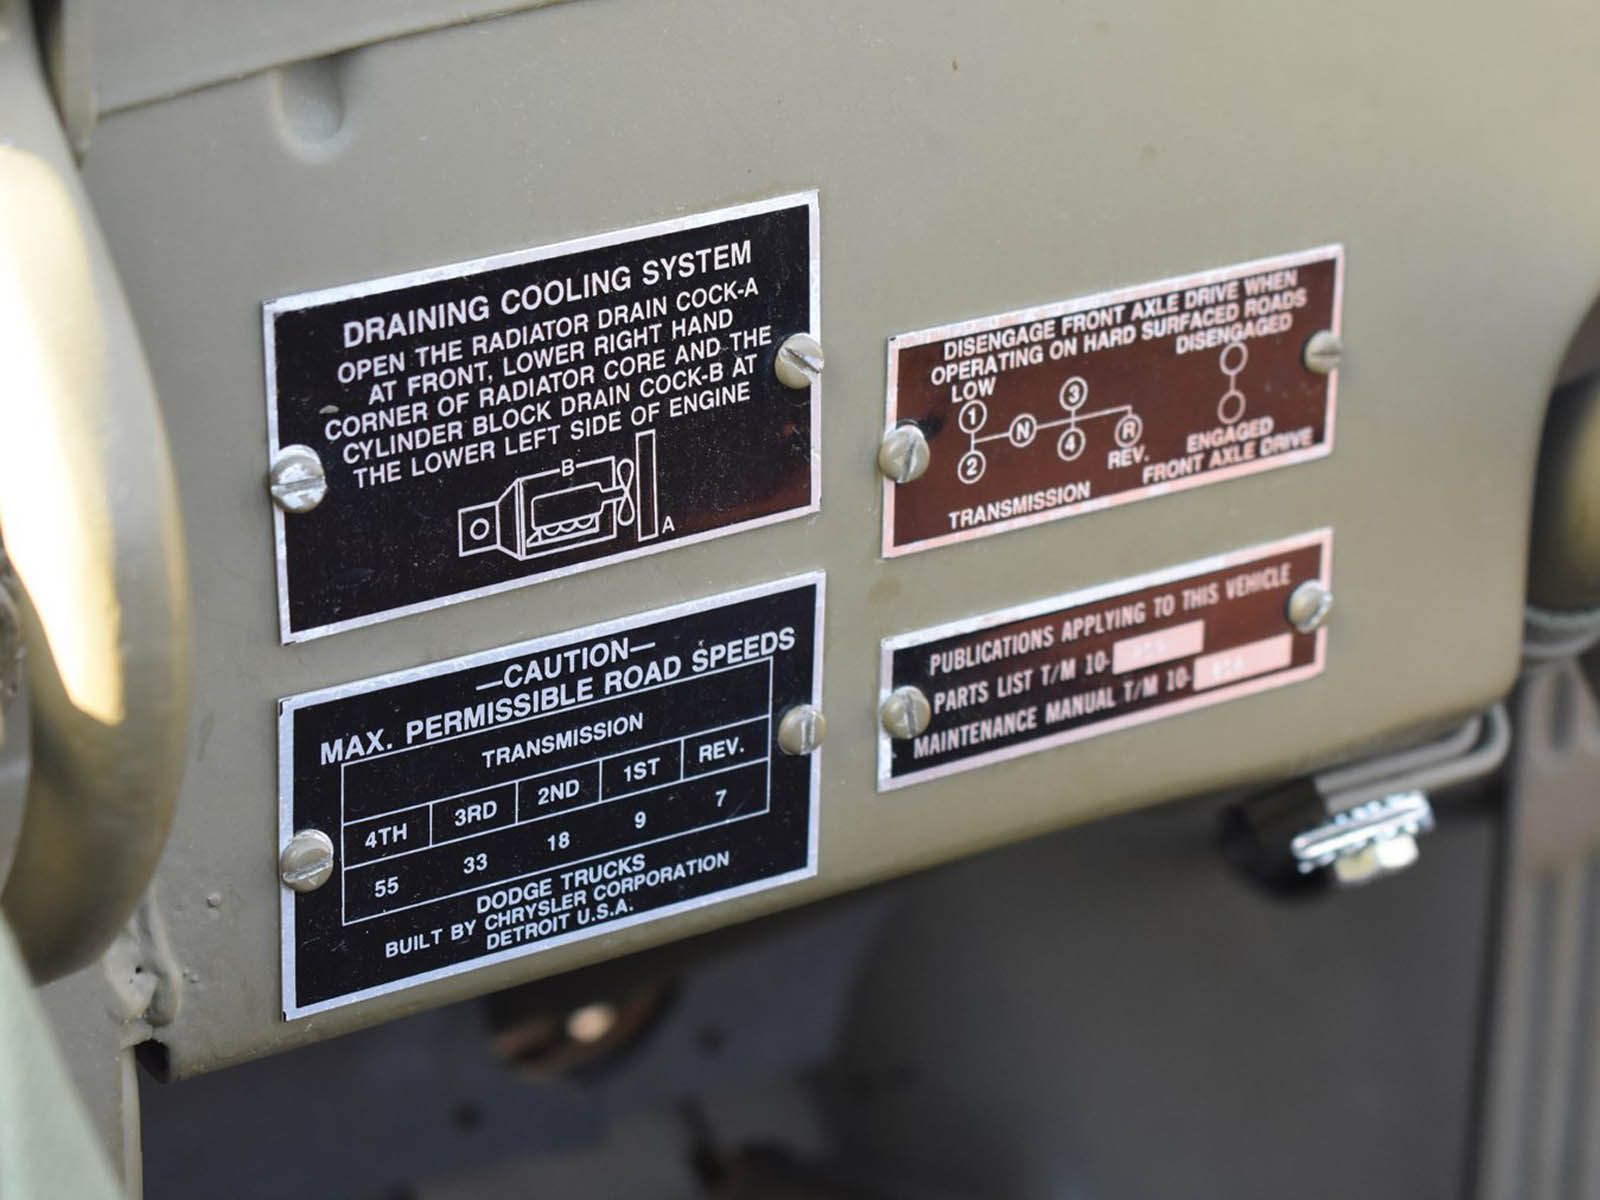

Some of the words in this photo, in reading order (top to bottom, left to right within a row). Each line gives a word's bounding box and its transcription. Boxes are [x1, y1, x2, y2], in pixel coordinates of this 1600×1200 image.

[337, 352, 405, 384] OPEN
[415, 340, 463, 368] THE
[472, 313, 588, 356] RADIATOR
[598, 296, 667, 329] DRAIN
[676, 277, 759, 311] COCK-A
[343, 295, 490, 348] DRAINING
[501, 266, 631, 315] COOLING
[642, 240, 751, 286] SYSTEM
[931, 345, 1044, 385] OPERATING
[1049, 338, 1077, 360] ON
[1083, 325, 1137, 353] HARD
[1141, 302, 1240, 341] SURFACED
[1244, 288, 1307, 318] ROADS
[943, 319, 1056, 361] DISENGAGE
[1061, 304, 1126, 335] FRONT
[1131, 293, 1180, 321] AXLE
[1184, 280, 1239, 310] DRIVE
[1243, 269, 1298, 297] WHEN
[1175, 312, 1294, 354] DISENGAGED
[325, 402, 428, 441] CORNER
[437, 392, 469, 417] OF
[480, 365, 595, 408] RADIATOR
[603, 349, 666, 381] CORE
[675, 337, 721, 365] AND
[730, 325, 772, 351] THE
[368, 380, 397, 405] AT
[407, 361, 493, 397] FRONT,
[504, 341, 584, 377] LOWER
[595, 323, 662, 356] RIGHT
[672, 308, 733, 339] HAND
[951, 376, 996, 403] LOW
[343, 421, 463, 464] CYLINDER
[473, 401, 551, 437] BLOCK
[561, 383, 630, 417] DRAIN
[640, 362, 723, 398] COCK-B
[732, 354, 758, 378] AT
[353, 461, 401, 488] THE
[412, 440, 495, 477] LOWER
[505, 425, 561, 455] LEFT
[570, 411, 622, 440] SIDE
[631, 402, 660, 426] OF
[670, 381, 750, 418] ENGINE
[1186, 416, 1274, 453] ENGAGED
[561, 458, 575, 477] B
[1107, 445, 1149, 470] REV.
[1142, 453, 1205, 485] FRONT
[1209, 442, 1257, 469] AXLE
[1259, 426, 1313, 457] DRIVE
[661, 516, 675, 534] A
[948, 480, 1092, 530] TRANSMISSION
[929, 625, 1054, 677] PUBLICATIONS
[1061, 602, 1146, 643] APPLYING
[1153, 594, 1176, 617] TO
[1182, 582, 1219, 611] THIS
[1225, 562, 1291, 599] VEHICLE
[320, 729, 393, 765] MAX.
[406, 677, 593, 744] PERMISSIBLE
[605, 656, 681, 695] ROAD
[692, 627, 796, 673] SPEEDS
[913, 706, 1038, 759] MAINTENANCE
[1045, 687, 1116, 725] MANUAL
[1123, 675, 1159, 702] T/M
[934, 681, 989, 715] PARTS
[997, 668, 1033, 698] LIST
[1040, 658, 1076, 686] T/M
[482, 712, 644, 768] TRANSMISSION
[365, 823, 408, 849] 4TH
[454, 801, 498, 826] 3RD
[537, 779, 580, 805] 2ND
[623, 758, 660, 782] 1ST
[699, 737, 745, 763] REV.
[374, 876, 399, 898] 55
[463, 853, 488, 874] 33
[547, 831, 570, 851] 18
[634, 811, 646, 829] 9
[715, 788, 727, 807] 7
[476, 878, 552, 914] DODGE
[560, 853, 646, 890] TRUCKS
[385, 928, 443, 958] BUILT
[451, 919, 476, 941] BY
[485, 890, 586, 931] CHRYSLER
[593, 851, 730, 900] CORPORATION
[486, 913, 570, 950] DETROIT
[576, 898, 634, 925] U.S.A.
